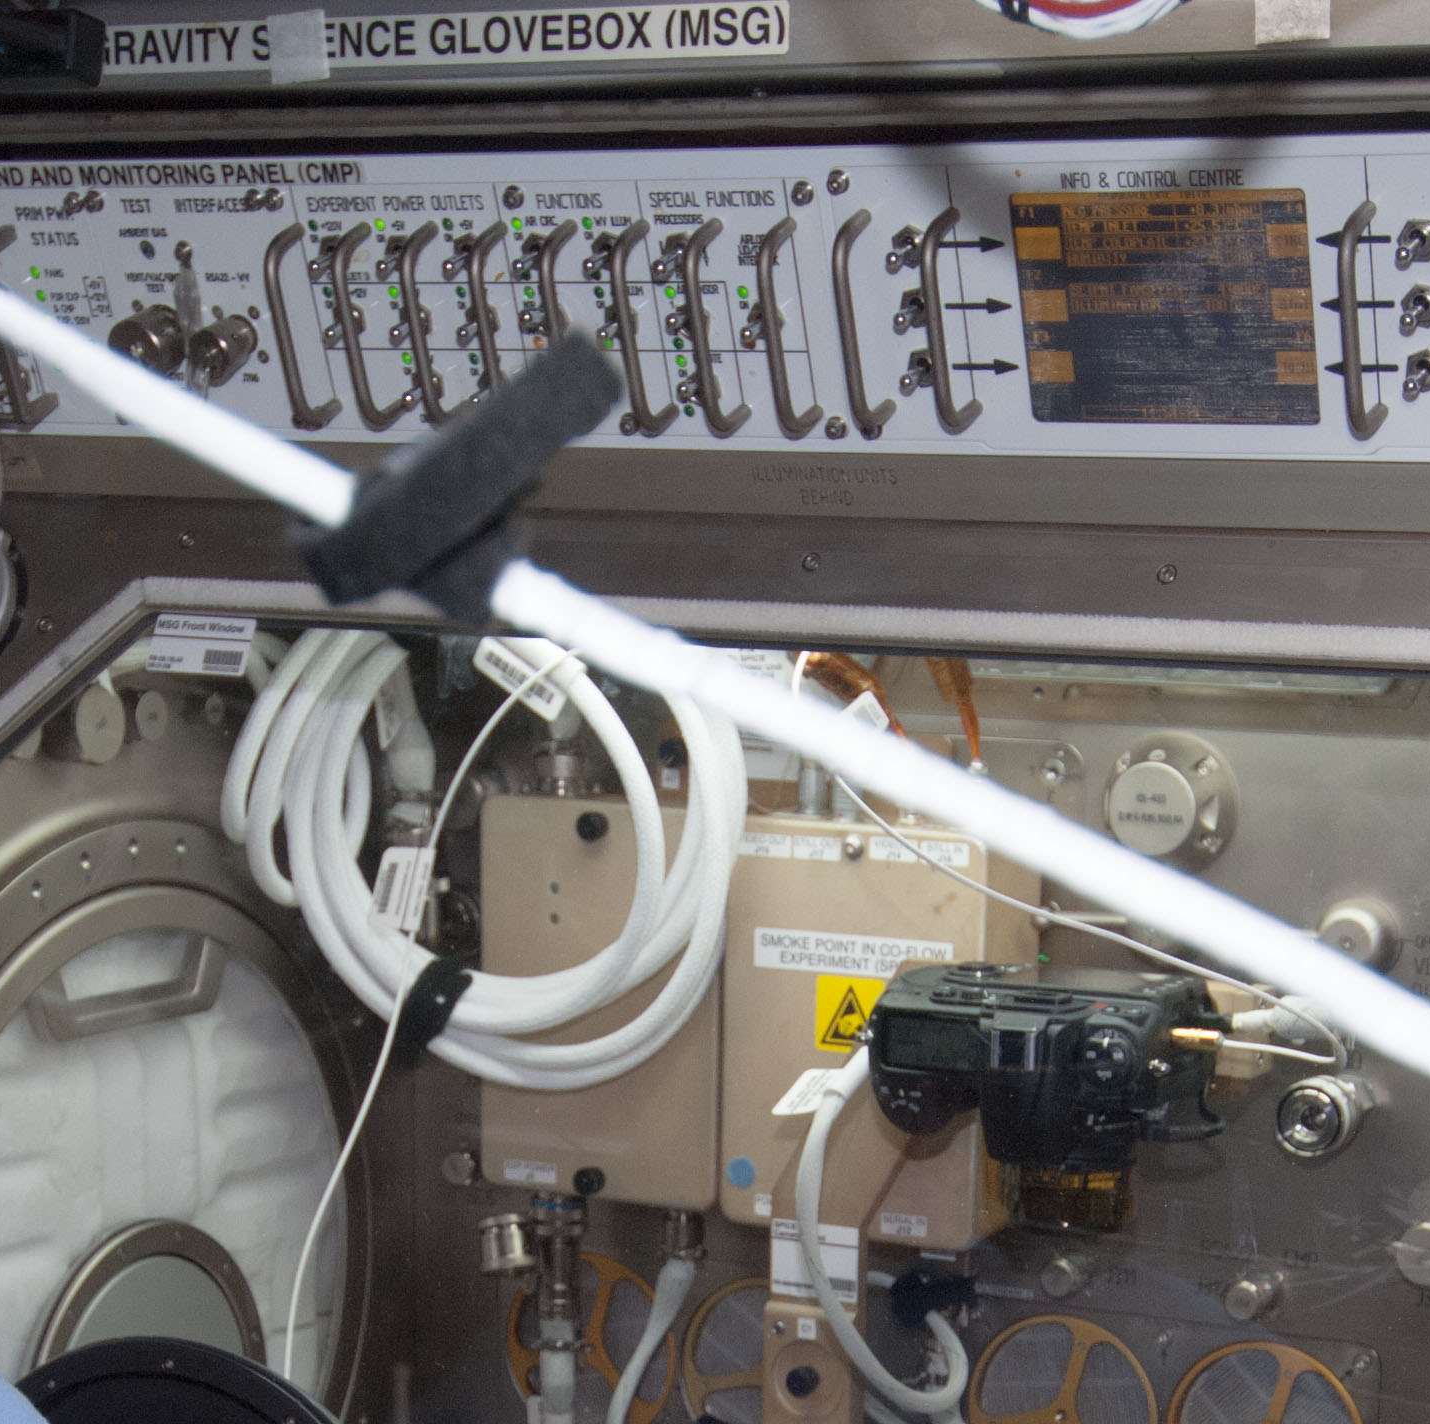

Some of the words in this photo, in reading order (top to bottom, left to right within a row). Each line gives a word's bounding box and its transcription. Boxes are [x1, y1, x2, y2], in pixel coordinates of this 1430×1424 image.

[430, 12, 652, 57] GLOVEBOX
[665, 6, 787, 51] (MSG)
[30, 164, 74, 187] AND
[78, 163, 216, 187] MONITORING
[222, 162, 295, 185] PANEL
[298, 161, 362, 186] (CMP)
[1060, 172, 1094, 190] INFO
[1098, 170, 1111, 189] &
[1116, 169, 1182, 189] CONTROL
[1186, 168, 1245, 187] CENTRE
[120, 198, 152, 214] TEST
[306, 196, 377, 213] EXPERIMENT
[383, 195, 427, 212] POWER
[431, 194, 485, 211] OUTLETS
[535, 192, 604, 210] FUNCTIONS
[648, 191, 700, 208] SPECIAL
[705, 190, 776, 208] FUNCTIONS
[157, 617, 179, 631] MSG
[181, 619, 206, 632] Front
[207, 621, 246, 634] Window
[760, 932, 811, 950] SMOKE
[814, 937, 859, 954] POINT
[862, 941, 876, 955] IN
[779, 952, 873, 971] EXPERIMENT
